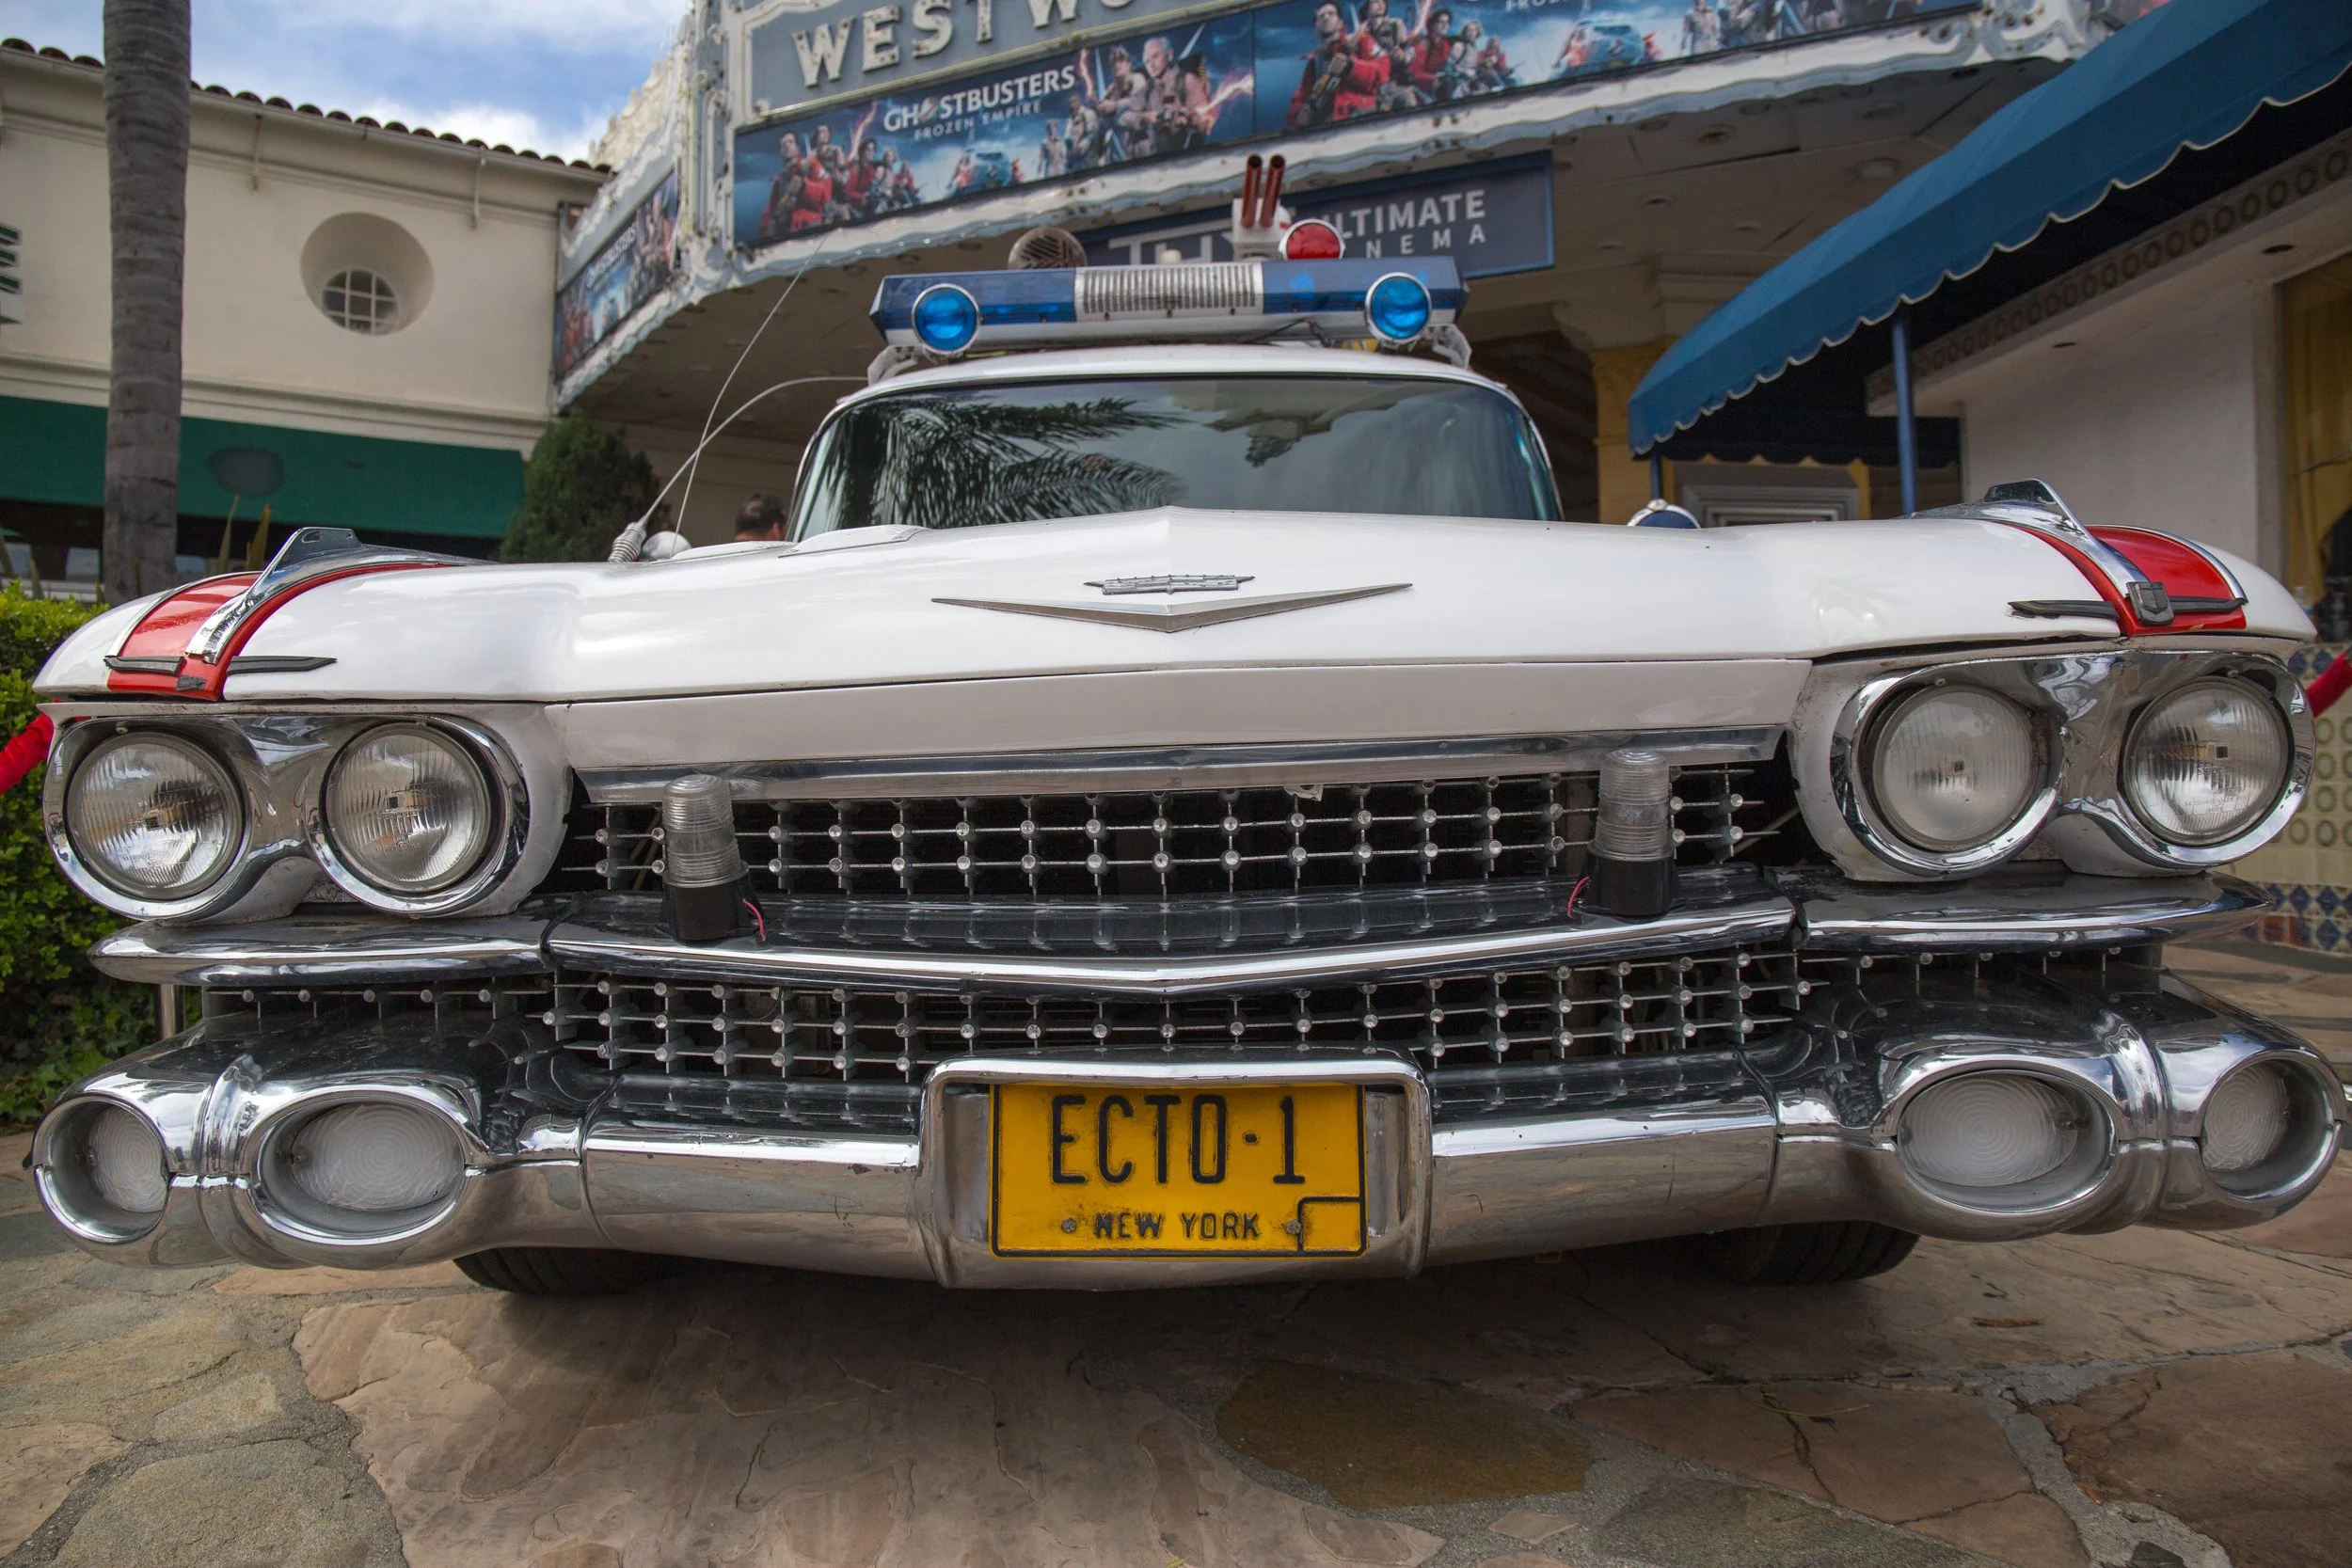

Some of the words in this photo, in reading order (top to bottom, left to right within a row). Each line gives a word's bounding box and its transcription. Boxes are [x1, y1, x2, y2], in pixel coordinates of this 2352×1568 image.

[883, 65, 1076, 132] GHOSTBUSTERS
[914, 117, 975, 141] FROZEN
[982, 100, 1041, 125] EMPIRE
[1320, 190, 1486, 239] LTIMATE
[1093, 1212, 1164, 1240] NEW
[1179, 1212, 1260, 1240] YORK
